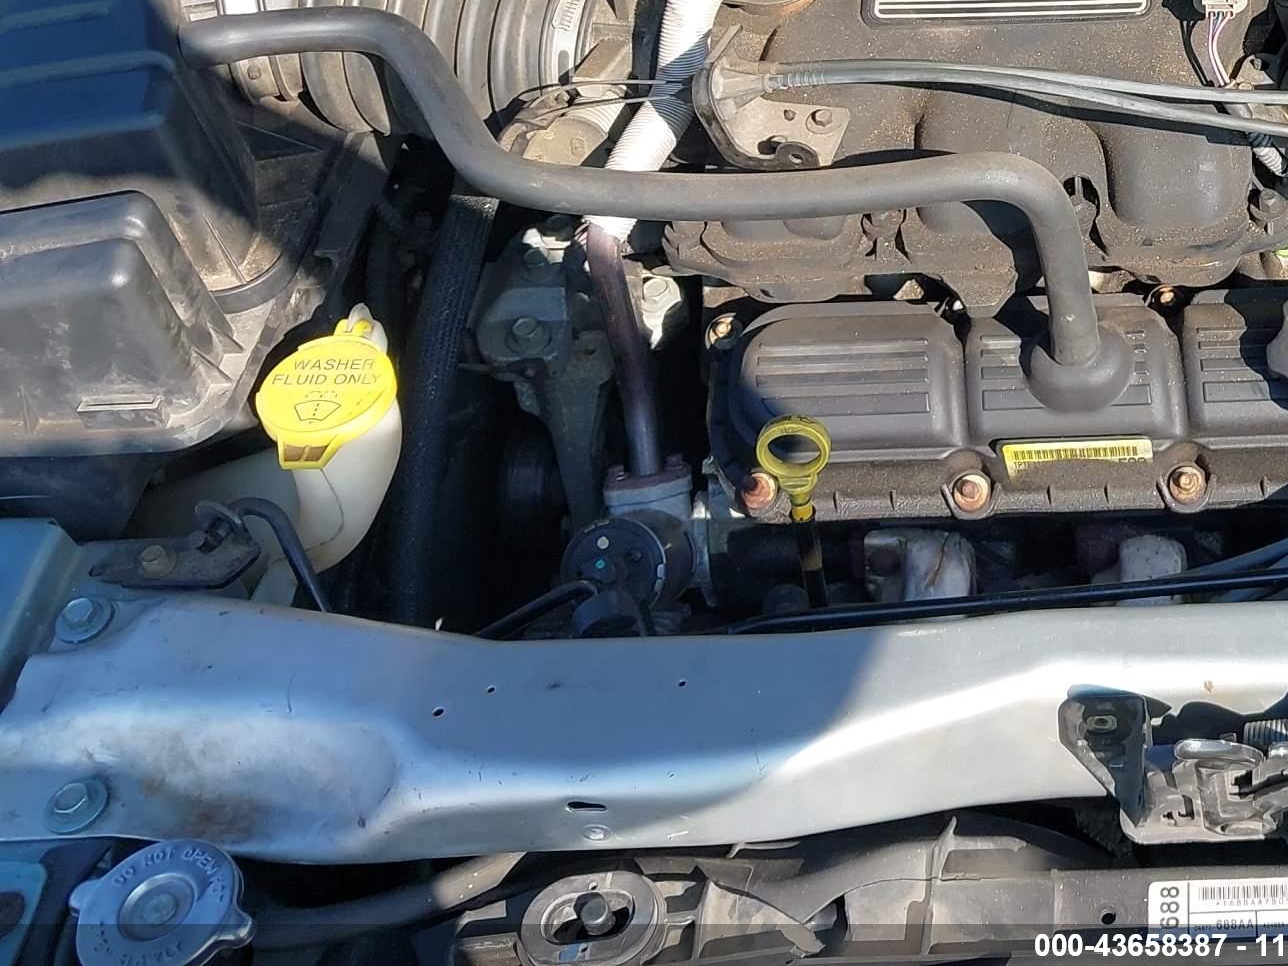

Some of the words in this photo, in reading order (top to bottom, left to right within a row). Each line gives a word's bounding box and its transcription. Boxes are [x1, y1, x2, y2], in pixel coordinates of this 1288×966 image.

[293, 358, 376, 371] WASHER
[272, 373, 327, 385] FLUID
[333, 373, 382, 385] ONLY
[143, 846, 176, 868] NOT
[182, 848, 218, 876] OPEN
[1159, 886, 1180, 930] 688
